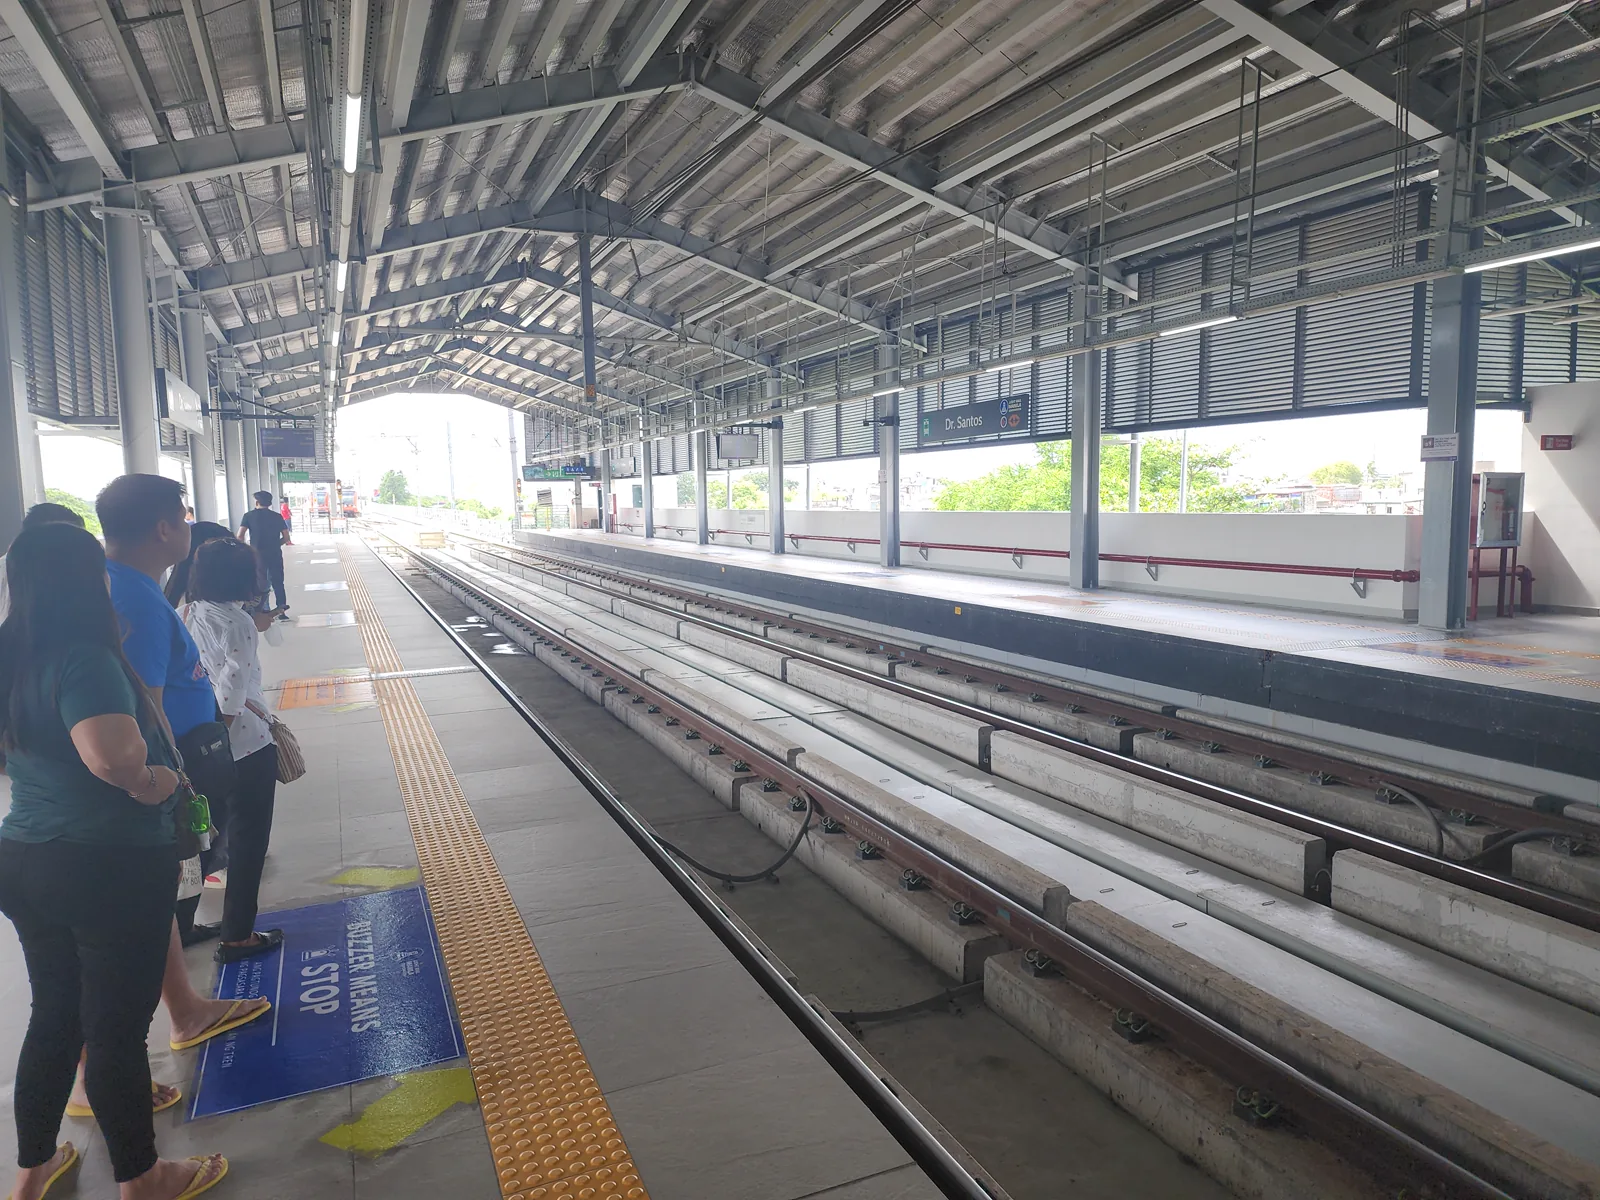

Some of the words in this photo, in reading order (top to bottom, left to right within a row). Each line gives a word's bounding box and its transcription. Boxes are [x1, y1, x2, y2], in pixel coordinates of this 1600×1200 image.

[945, 418, 956, 431] Dr.
[957, 416, 983, 429] Santos
[347, 920, 376, 974] BUZZER
[300, 962, 340, 1015] STOP
[350, 974, 382, 1033] MEANS
[221, 1051, 235, 1069] TREN
